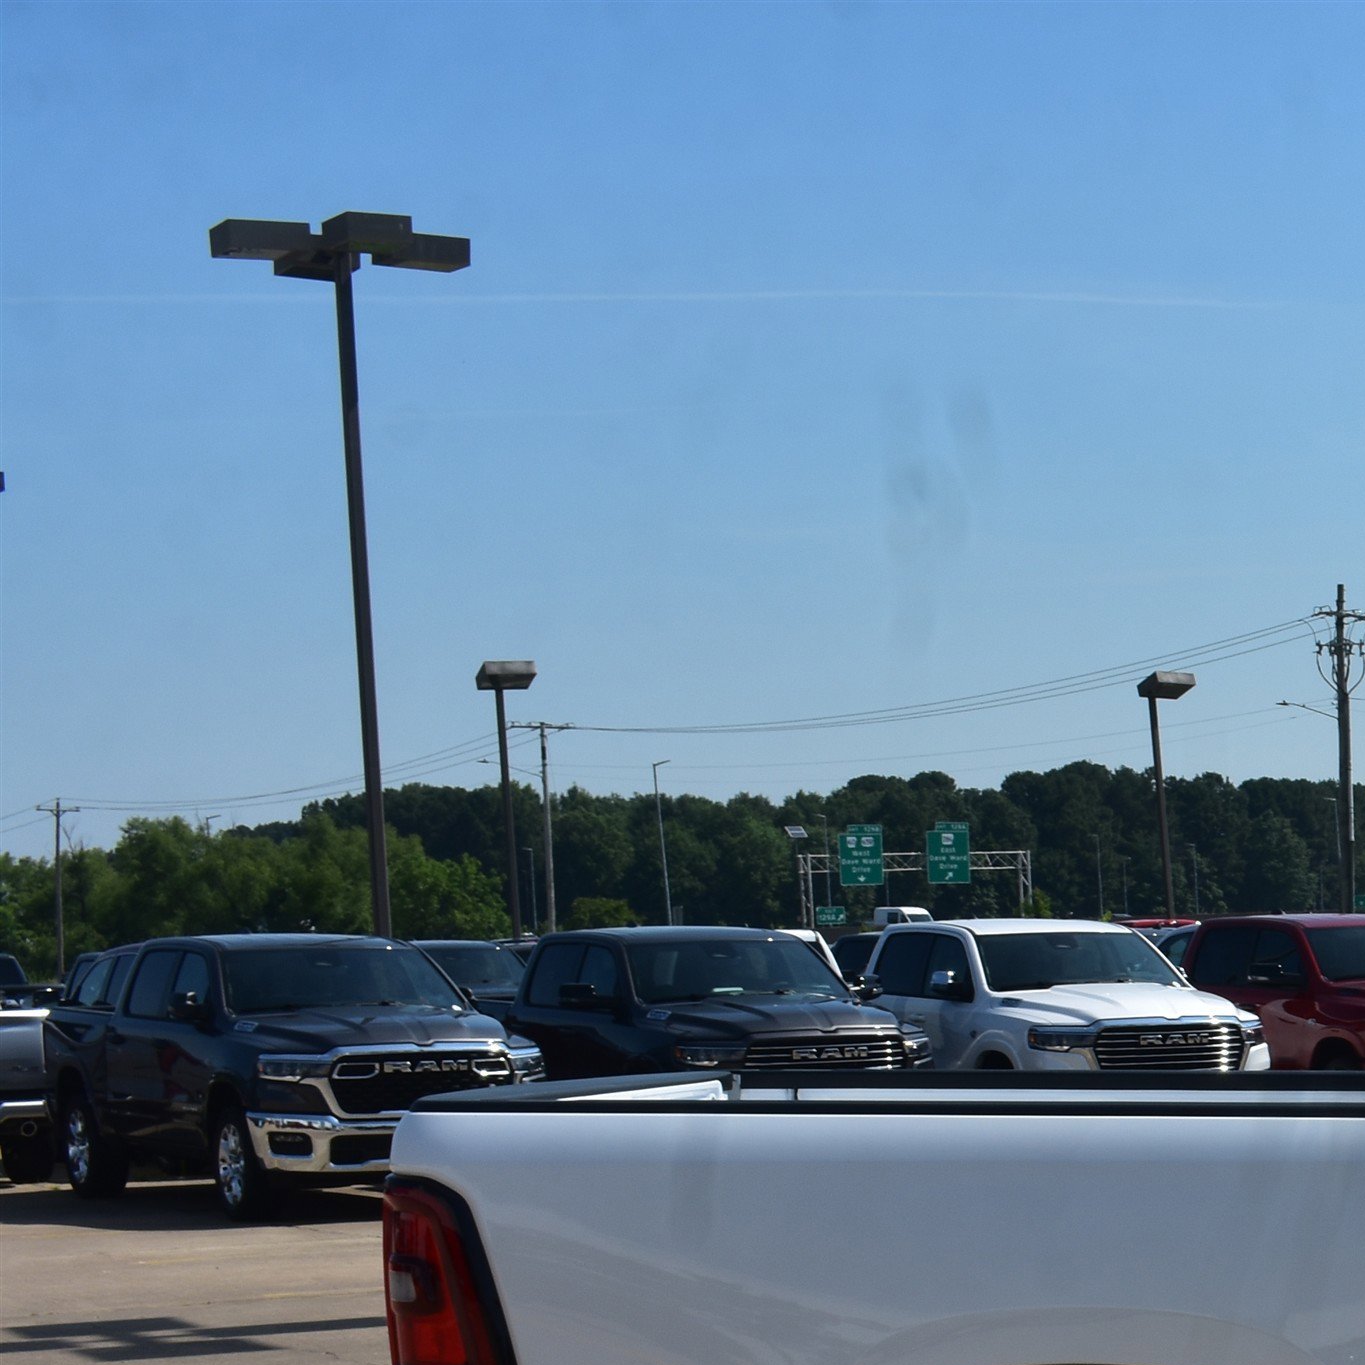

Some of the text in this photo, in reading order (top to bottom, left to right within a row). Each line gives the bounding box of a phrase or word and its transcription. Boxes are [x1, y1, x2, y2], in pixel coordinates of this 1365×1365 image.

[1139, 1033, 1209, 1046] RAM
[792, 1046, 868, 1060] RAM
[384, 1059, 468, 1073] RAM
